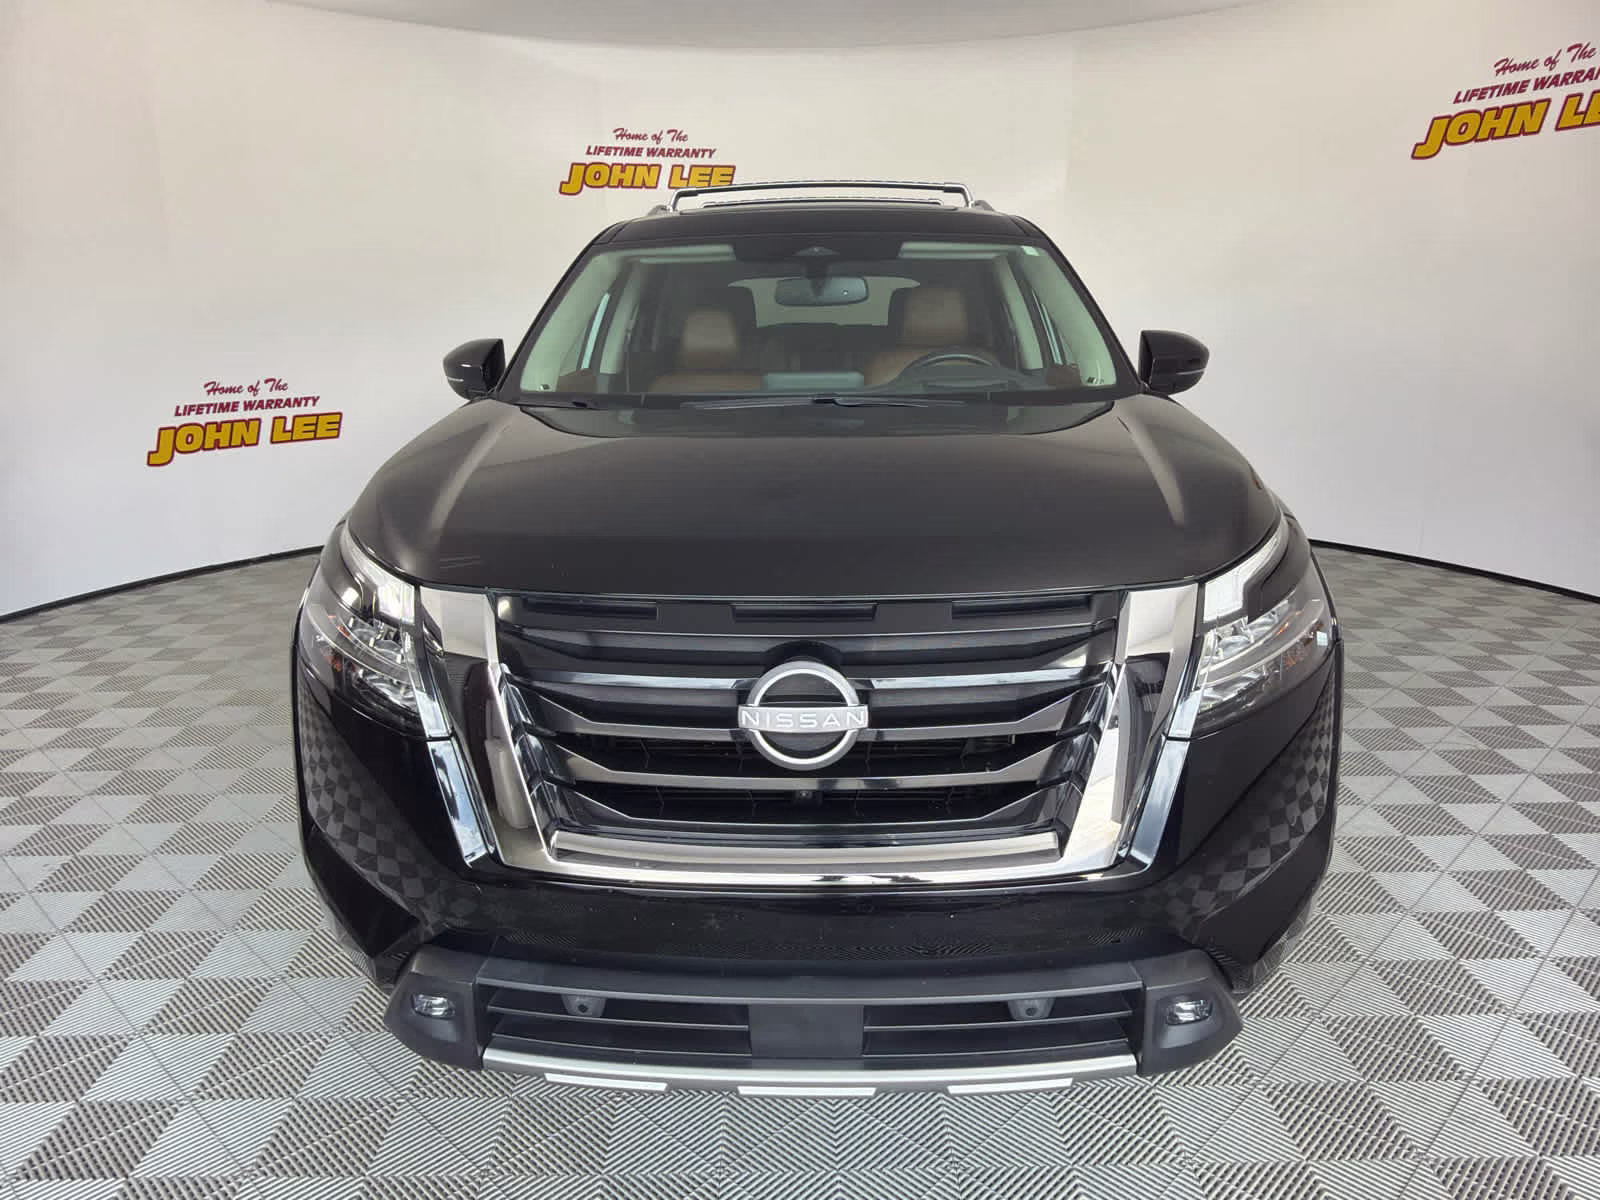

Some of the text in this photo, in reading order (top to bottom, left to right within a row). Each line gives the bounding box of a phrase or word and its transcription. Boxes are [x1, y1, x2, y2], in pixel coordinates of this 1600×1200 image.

[1494, 42, 1597, 76] Home of The
[1453, 79, 1531, 104] LIFETIME
[613, 127, 689, 144] Home of The
[1411, 98, 1552, 160] JOHN
[586, 146, 717, 159] LIFETIME WARRANTY
[559, 162, 736, 196] JOHN LEE
[203, 378, 289, 397] Home of The
[174, 396, 321, 417] LIFETIME WARRANTY
[147, 412, 343, 467] JOHN LEE
[741, 710, 865, 728] NISSAN
